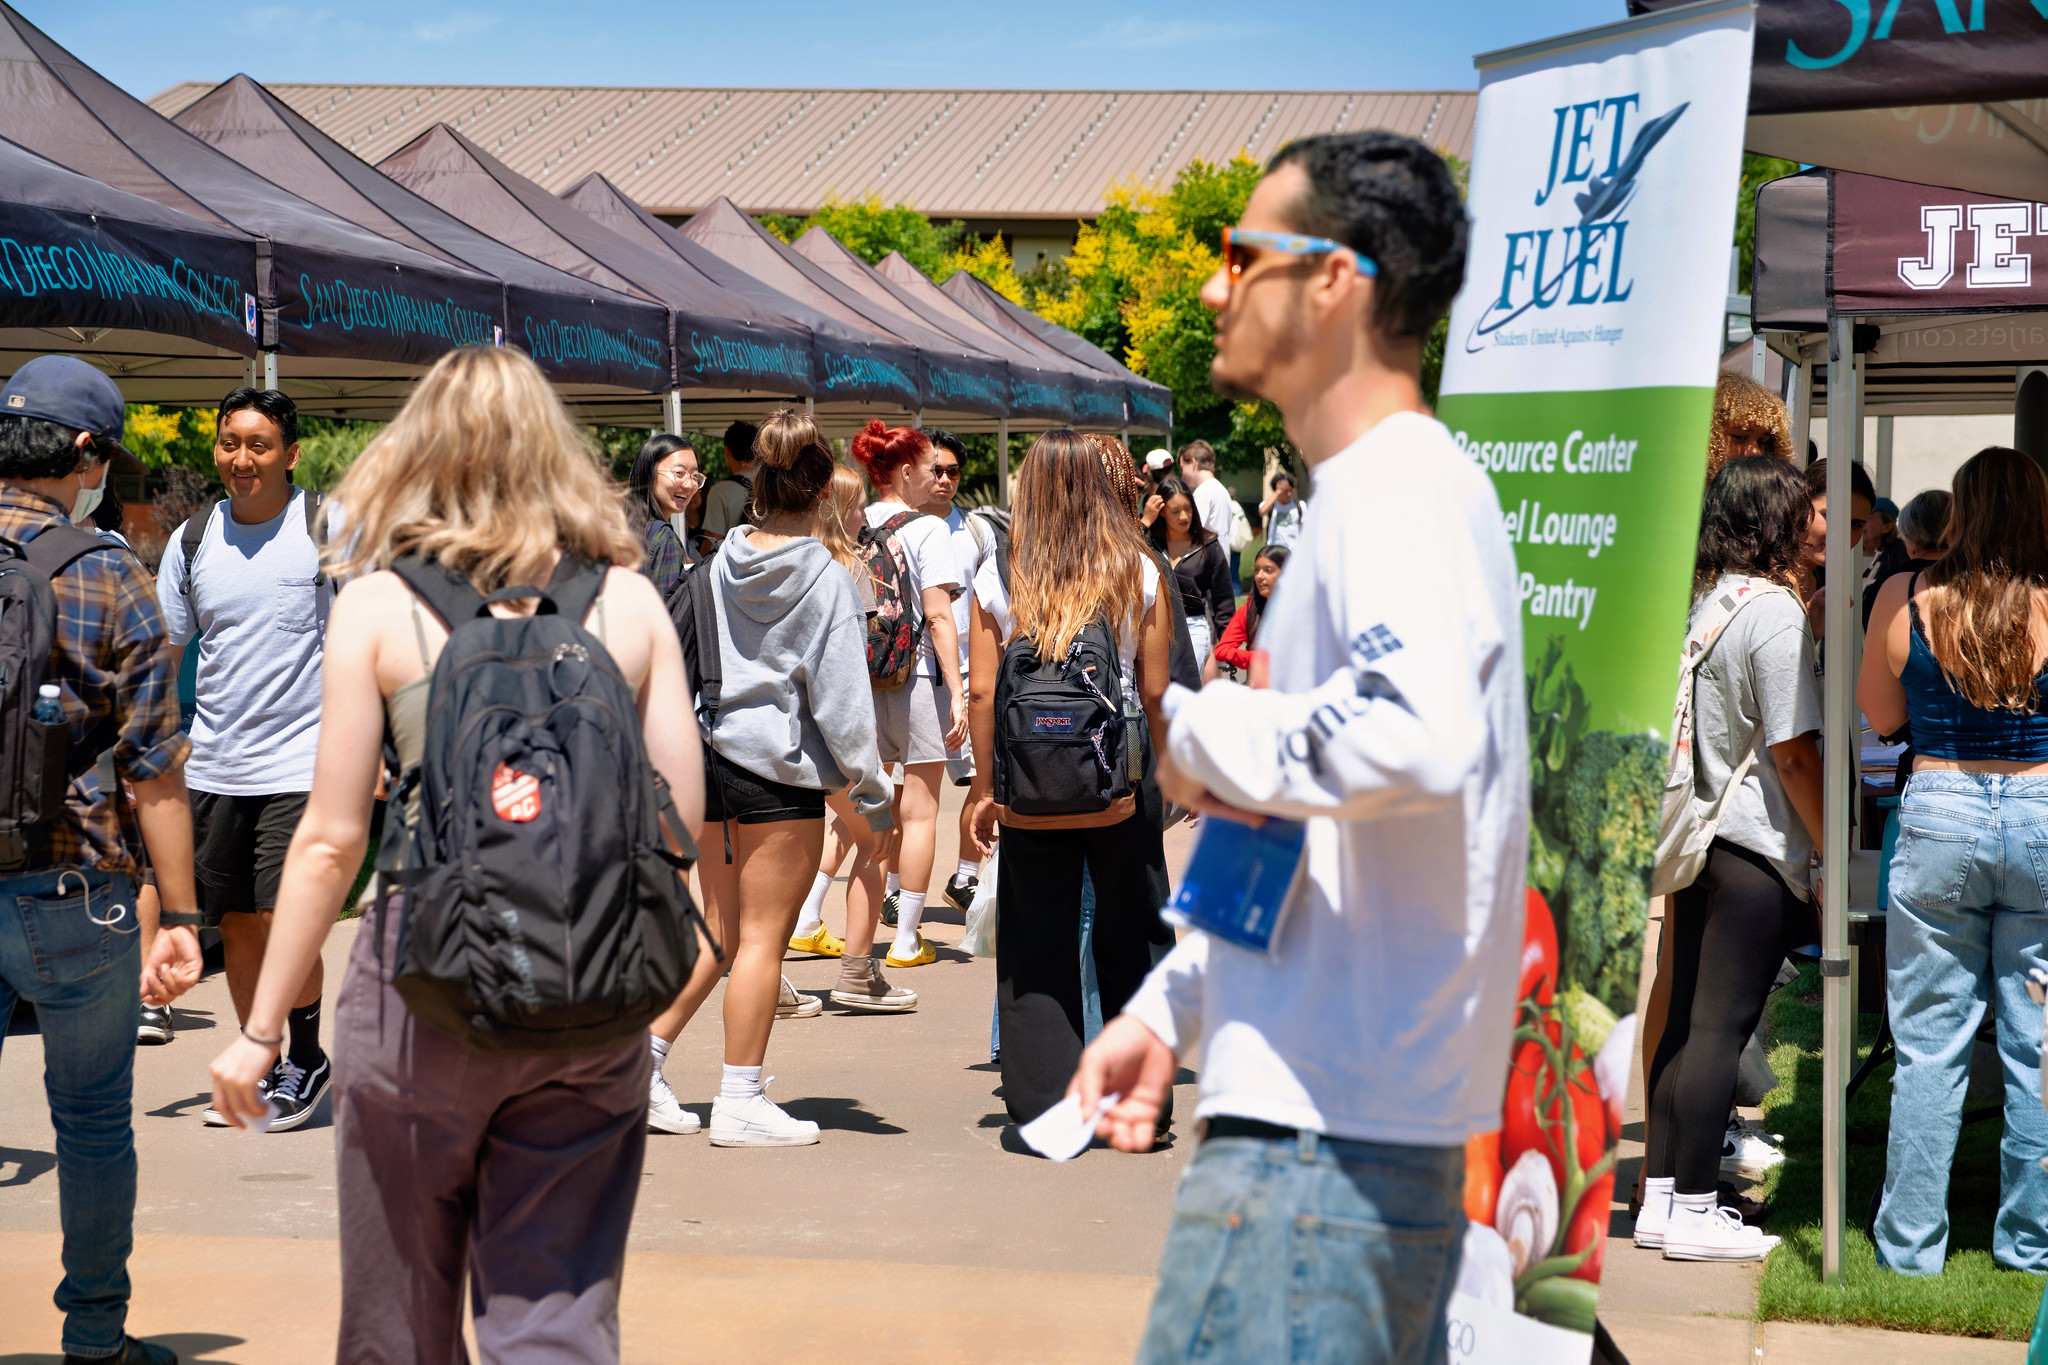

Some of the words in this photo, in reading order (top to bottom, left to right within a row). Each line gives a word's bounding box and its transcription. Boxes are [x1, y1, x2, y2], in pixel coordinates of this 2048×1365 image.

[1535, 93, 1640, 207] JET
[1494, 220, 1634, 310] FUEL
[1898, 201, 2048, 290] JE
[0, 237, 93, 297] DIEGO
[78, 238, 187, 303] MIRAMAR
[172, 257, 241, 322] COLLEGE
[300, 272, 338, 330] SAN
[334, 279, 387, 331] DIEGO
[381, 284, 450, 339] MIRAMAR
[445, 297, 493, 348] COLLEGE
[524, 315, 552, 364] SAN
[550, 319, 588, 363] DIEGO
[1492, 330, 1529, 347] Students
[1530, 328, 1557, 345] United
[1559, 327, 1593, 347] Against
[1594, 325, 1624, 348] Hunger
[691, 331, 719, 373] SAN
[713, 335, 750, 373] DIEGO
[1562, 430, 1638, 474] Center
[1529, 501, 1618, 559] Lounge
[1518, 571, 1598, 631] Pantry
[1035, 716, 1071, 728] JANSPORT
